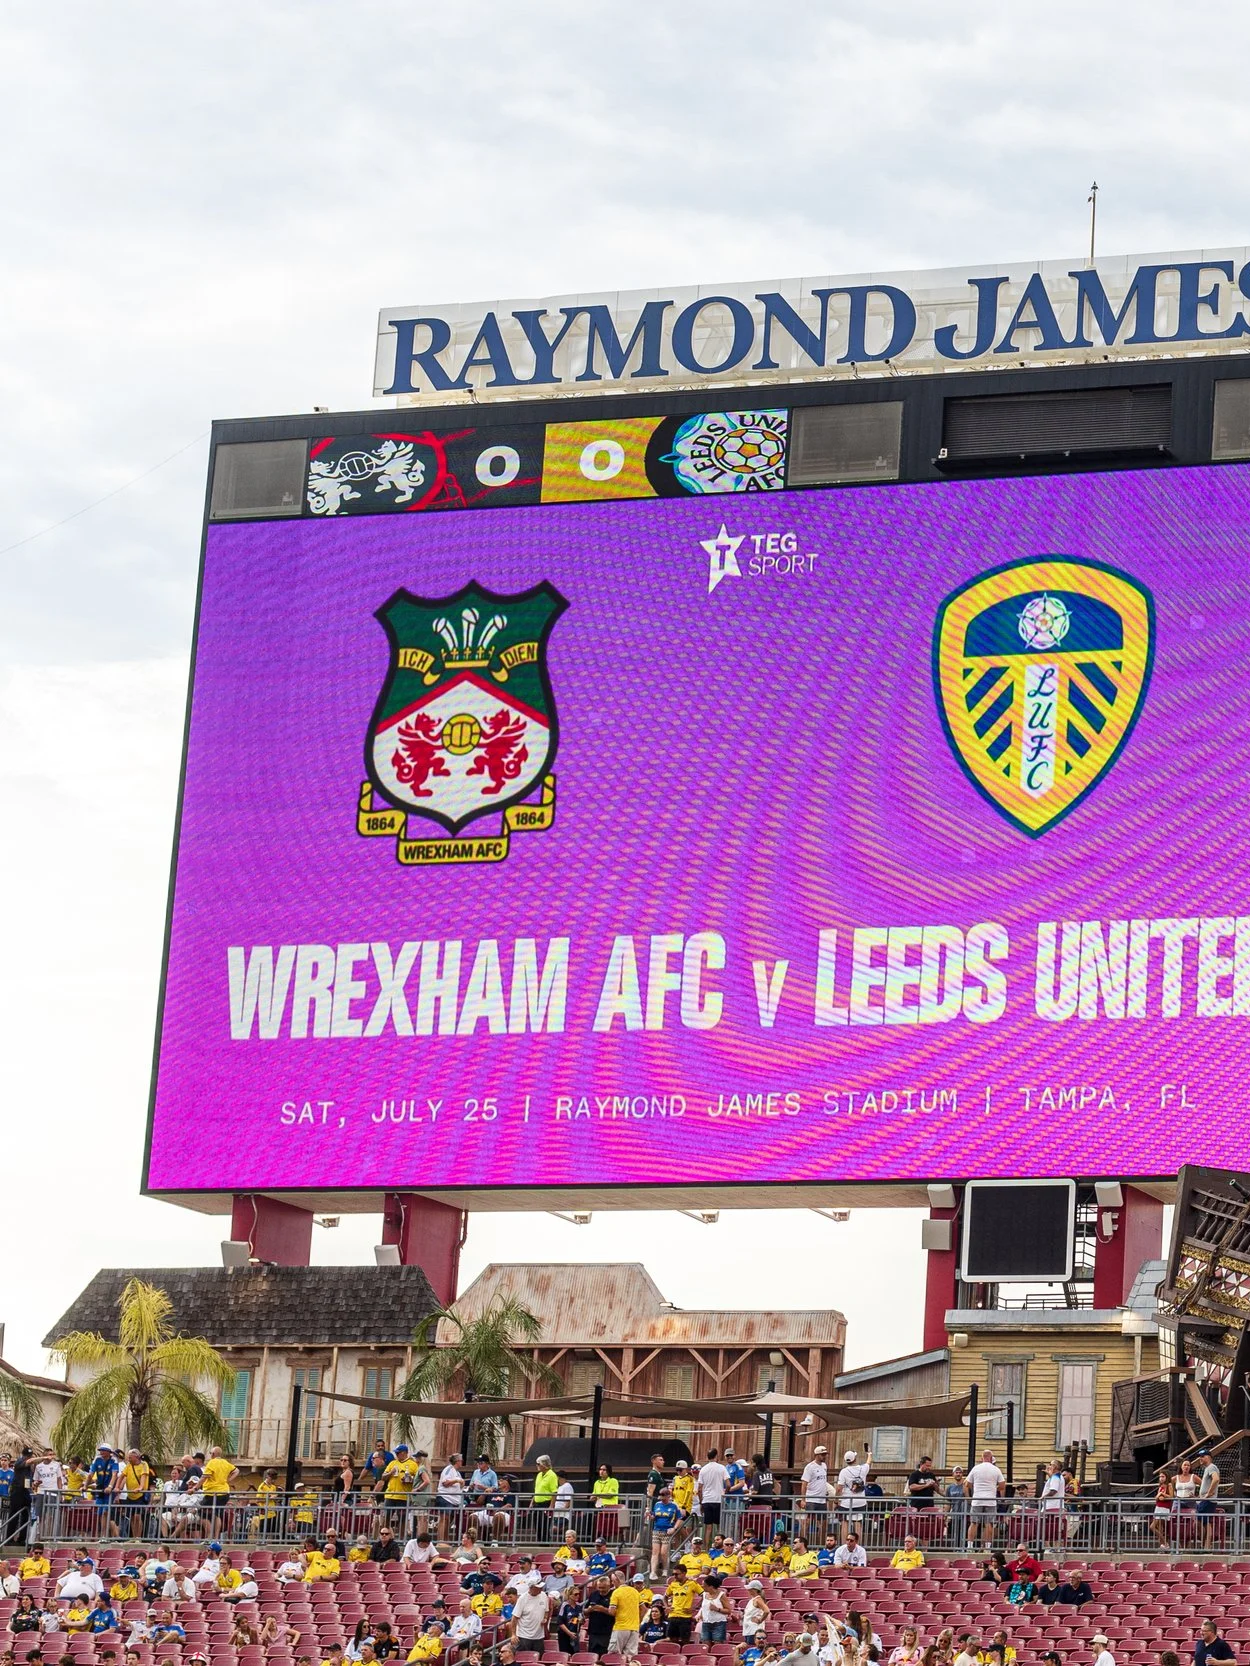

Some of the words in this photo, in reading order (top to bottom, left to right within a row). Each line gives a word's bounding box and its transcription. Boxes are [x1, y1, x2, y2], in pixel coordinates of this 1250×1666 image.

[382, 284, 917, 395] RAYMOND
[738, 414, 787, 436] UNI
[579, 439, 625, 481] 0
[691, 423, 727, 483] LEEDS
[475, 445, 521, 487] 0
[750, 532, 797, 554] TEG
[748, 553, 819, 576] SPORT
[403, 650, 428, 670] ICH
[504, 643, 536, 666] DIEN
[366, 817, 395, 831] 1864
[514, 811, 545, 826] 1864
[404, 845, 474, 861] WREXHAM
[475, 843, 503, 858] AFC
[227, 937, 570, 1040] WREXHAM
[592, 933, 726, 1032] AFC
[814, 922, 1009, 1026] LEEDS
[280, 1101, 346, 1128] SAT,
[371, 1099, 443, 1123] JULY
[463, 1098, 498, 1121] 25
[555, 1094, 686, 1120] RAYMOND
[707, 1092, 801, 1117] JAMES
[823, 1088, 958, 1116] STADIUM
[1019, 1086, 1132, 1113] TAMPA,
[1160, 1084, 1197, 1109] FL
